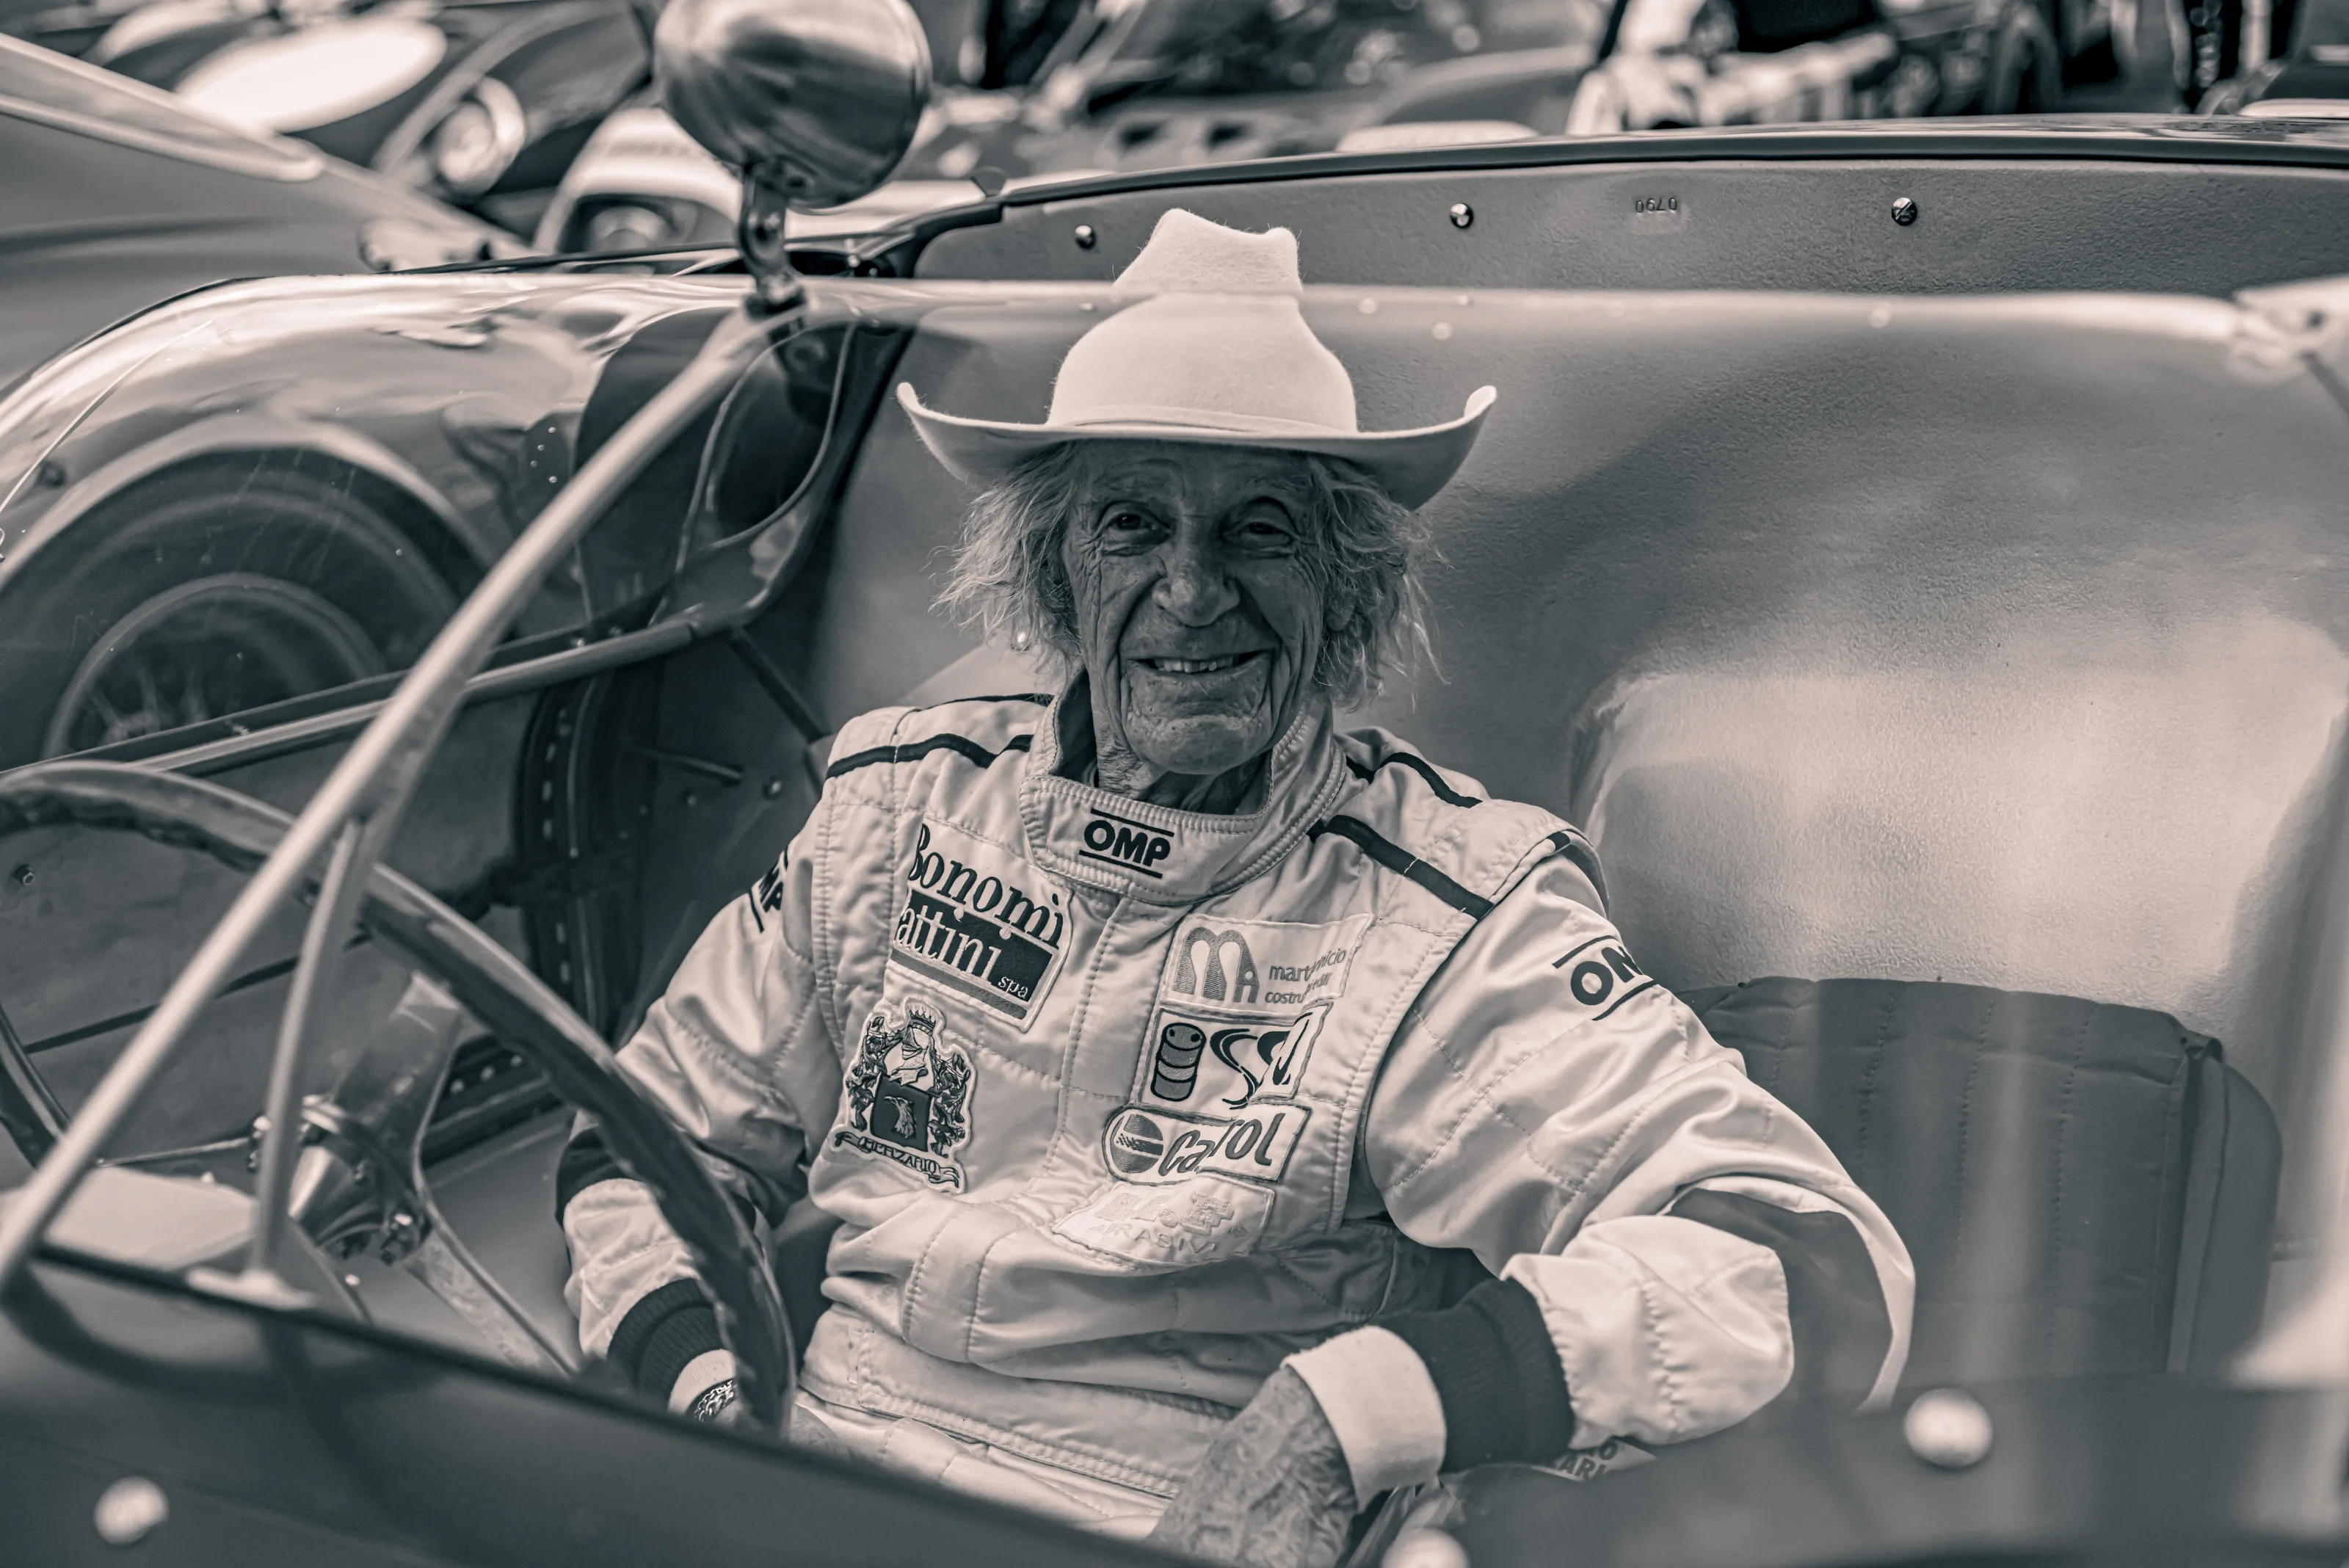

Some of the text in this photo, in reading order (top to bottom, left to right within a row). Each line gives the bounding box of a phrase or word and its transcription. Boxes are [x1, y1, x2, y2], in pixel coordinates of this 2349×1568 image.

[1083, 819, 1172, 867] OMP
[907, 823, 1064, 949] Bonomi
[897, 904, 1029, 1001] attini spa
[1570, 945, 1643, 1006] OM
[1158, 1112, 1286, 1177] Carol
